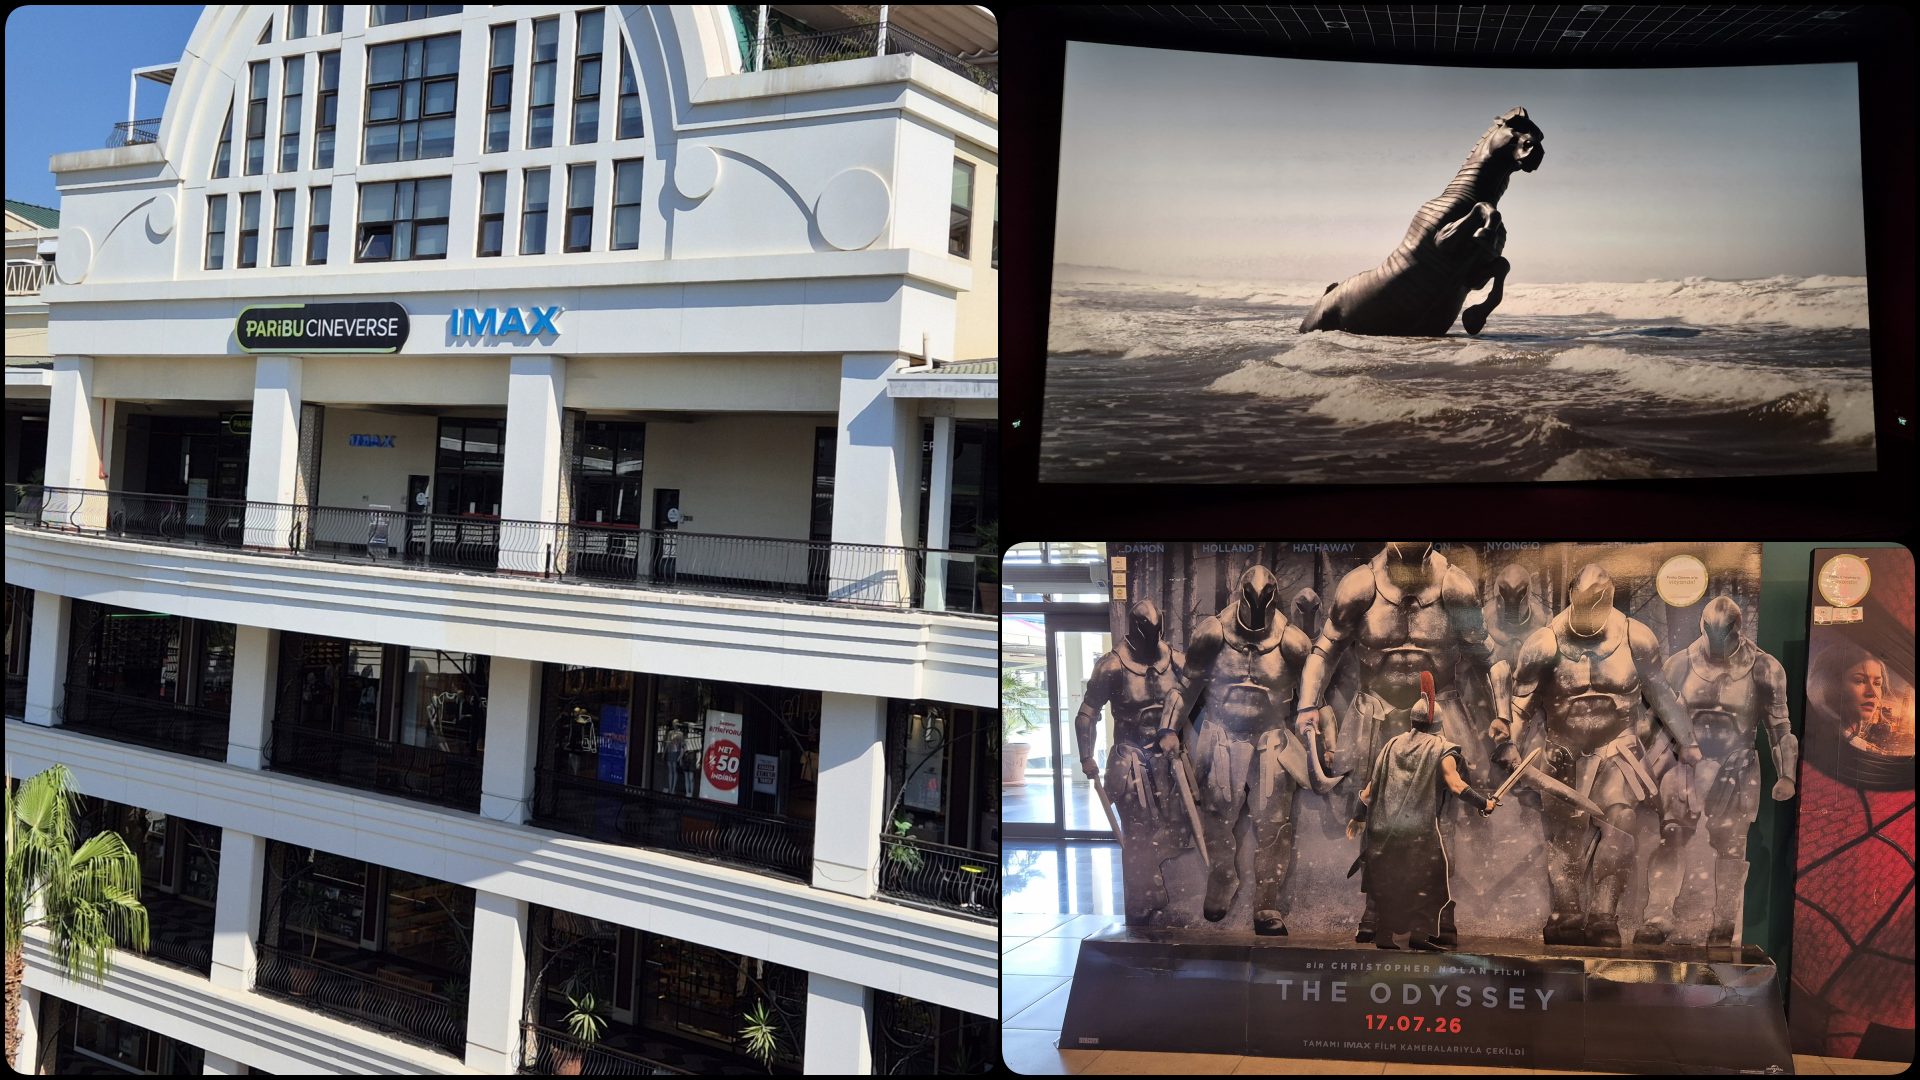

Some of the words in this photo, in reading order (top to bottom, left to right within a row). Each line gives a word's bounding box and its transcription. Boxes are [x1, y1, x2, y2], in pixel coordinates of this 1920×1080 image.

[306, 318, 398, 337] CINEVERSE
[450, 305, 560, 336] IMAX
[1124, 544, 1165, 553] DAMON
[1202, 543, 1255, 553] HOLLAND
[1292, 543, 1356, 553] HATHAWAY
[718, 745, 734, 754] NET
[1331, 962, 1430, 973] CHRISTOPHER
[1439, 965, 1487, 975] NOLAN
[1494, 968, 1526, 977] FİLMİ
[1277, 978, 1347, 1003] THE
[1370, 982, 1555, 1011] ODYSSEY
[1366, 1014, 1462, 1034] 17.07.26
[1303, 1040, 1340, 1048] TAMAMI
[1343, 1041, 1371, 1049] IMAX
[1374, 1041, 1397, 1050] FİLM
[1400, 1043, 1482, 1054] KAMERALARIYLA
